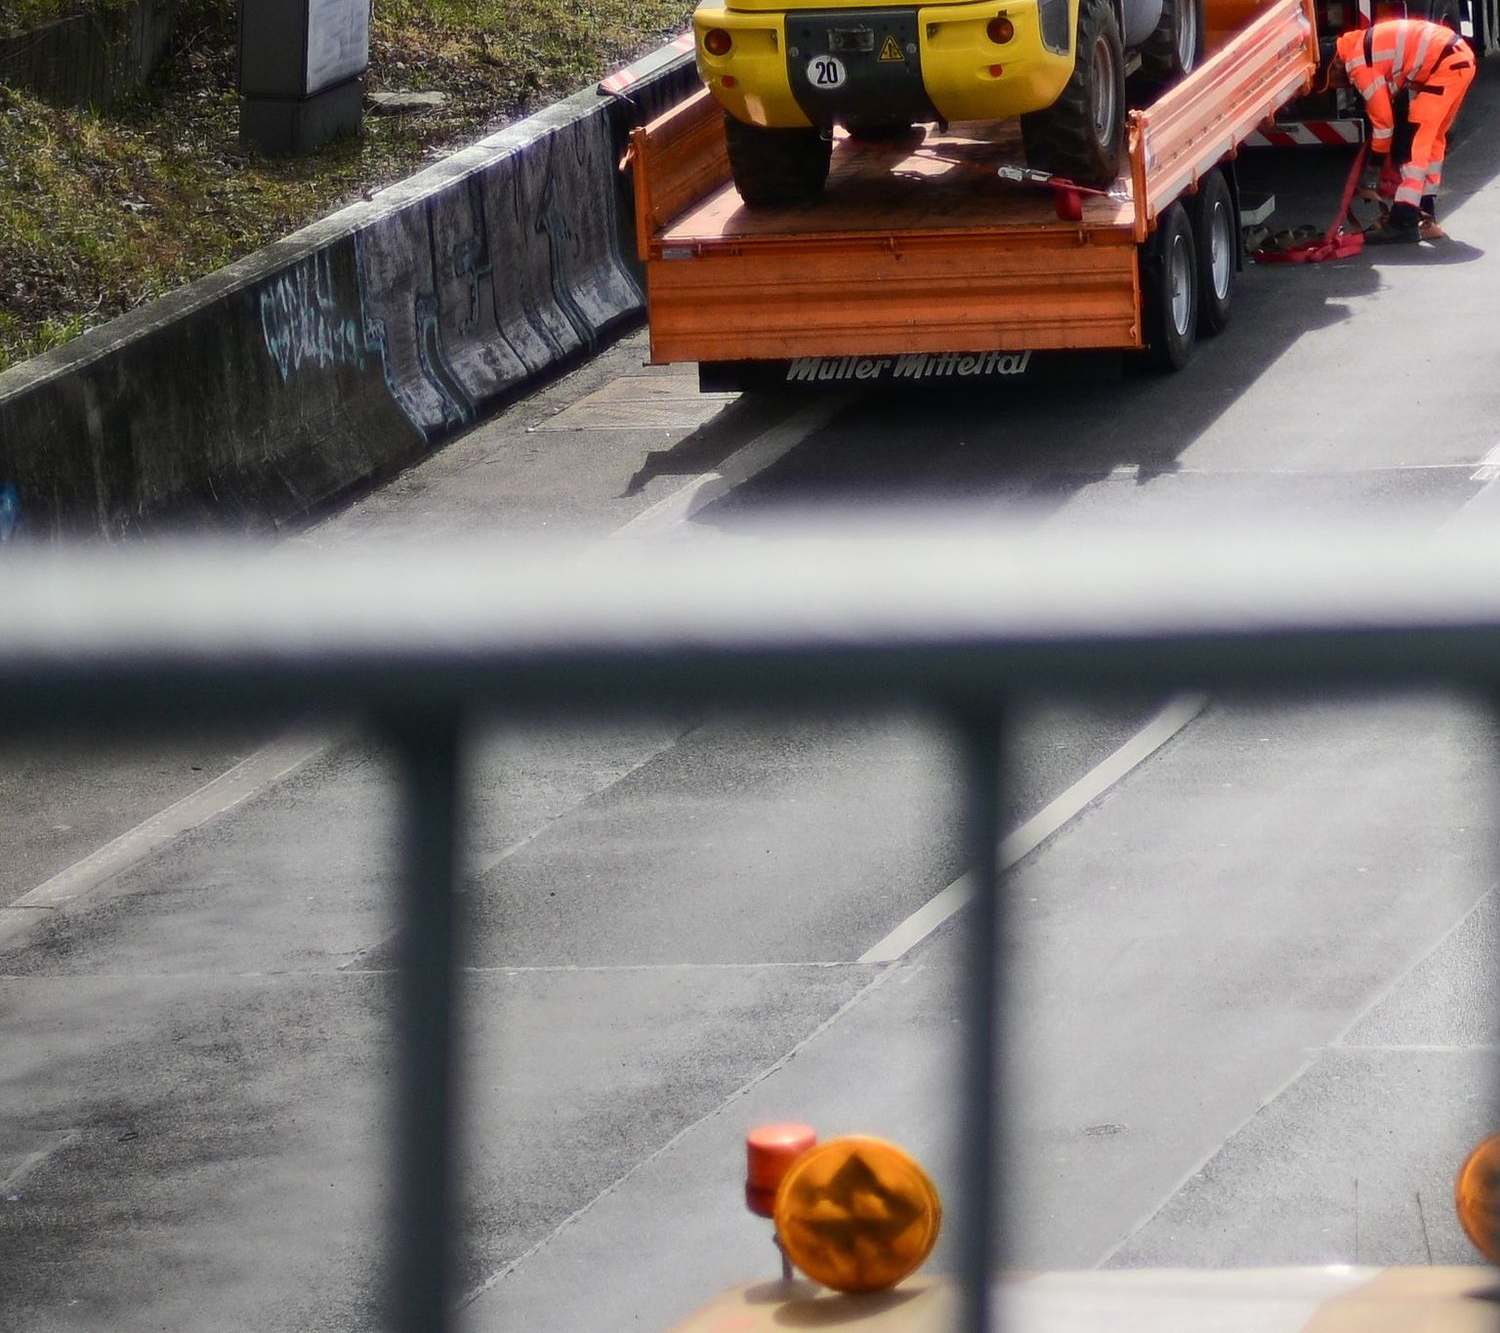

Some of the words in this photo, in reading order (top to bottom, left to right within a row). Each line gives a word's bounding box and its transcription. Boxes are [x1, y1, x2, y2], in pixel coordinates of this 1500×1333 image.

[815, 61, 838, 84] 20
[786, 355, 891, 381] Müller
[893, 349, 1032, 379] Mitteltal
